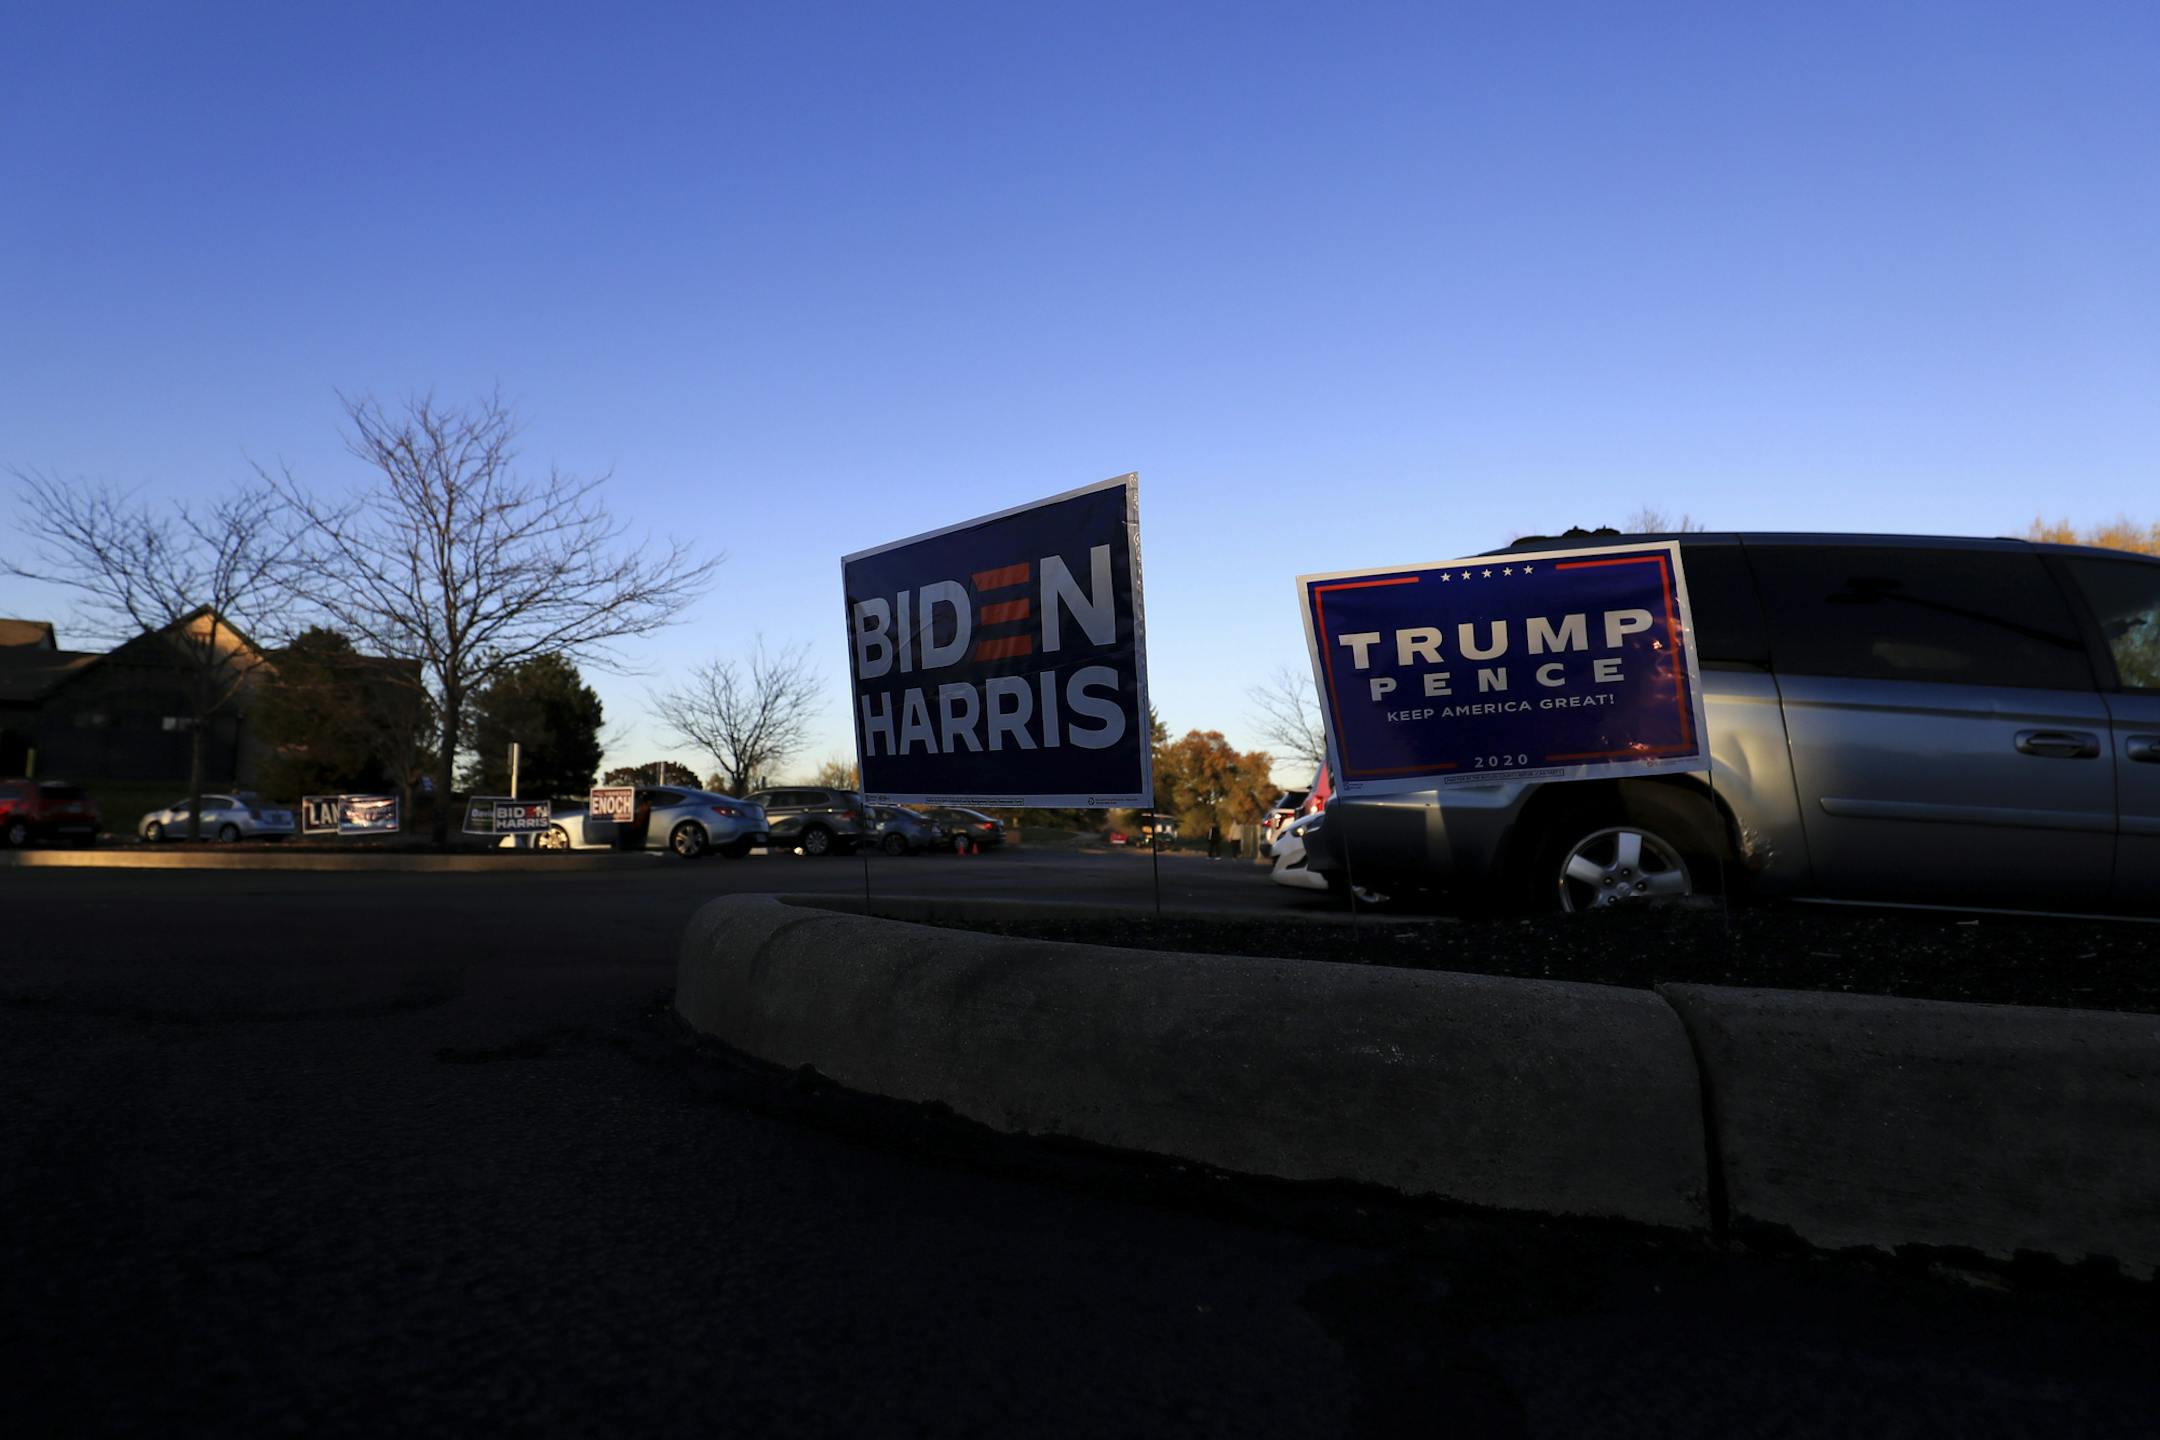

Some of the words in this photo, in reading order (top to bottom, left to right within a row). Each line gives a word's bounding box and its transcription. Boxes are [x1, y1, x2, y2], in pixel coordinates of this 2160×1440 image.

[853, 543, 1117, 680] BIDEN
[1338, 608, 1655, 670] TRUMP
[1369, 657, 1625, 702] PENCE
[861, 665, 1127, 757] HARRIS
[1387, 706, 1435, 723] KEEP
[1441, 700, 1533, 719] AMERICA
[1540, 693, 1616, 709] GREAT!
[1473, 754, 1529, 769] 2020
[496, 806, 548, 819] BIDEN
[592, 796, 631, 815] ENOCH
[496, 818, 548, 829] HARRIS
